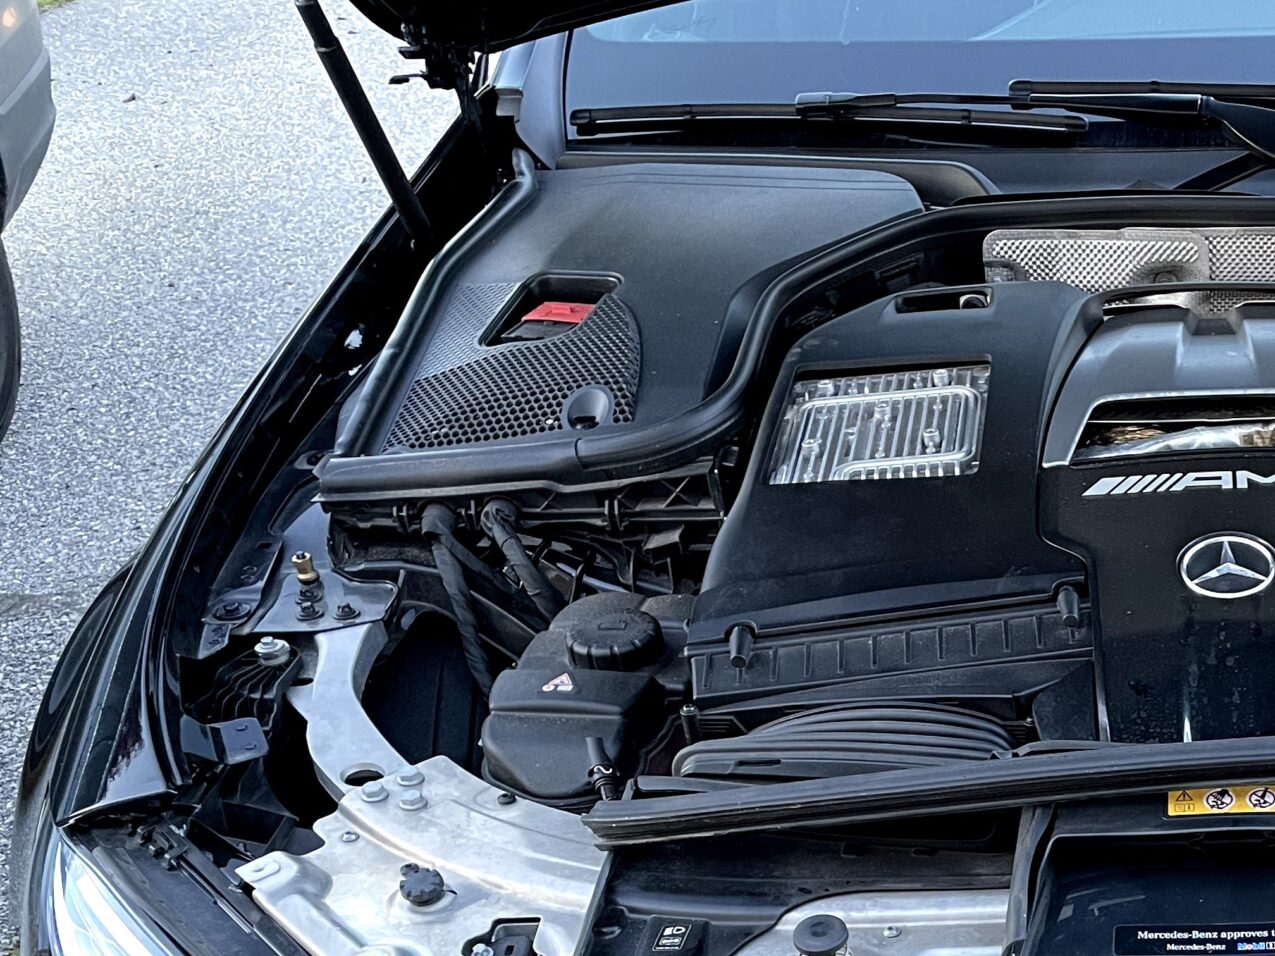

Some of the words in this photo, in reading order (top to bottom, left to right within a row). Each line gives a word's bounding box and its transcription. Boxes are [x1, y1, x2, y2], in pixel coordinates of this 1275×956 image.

[1137, 930, 1218, 939] Mercedes-Benz
[1220, 930, 1269, 940] approves
[1166, 943, 1226, 951] Mercedes-Benz
